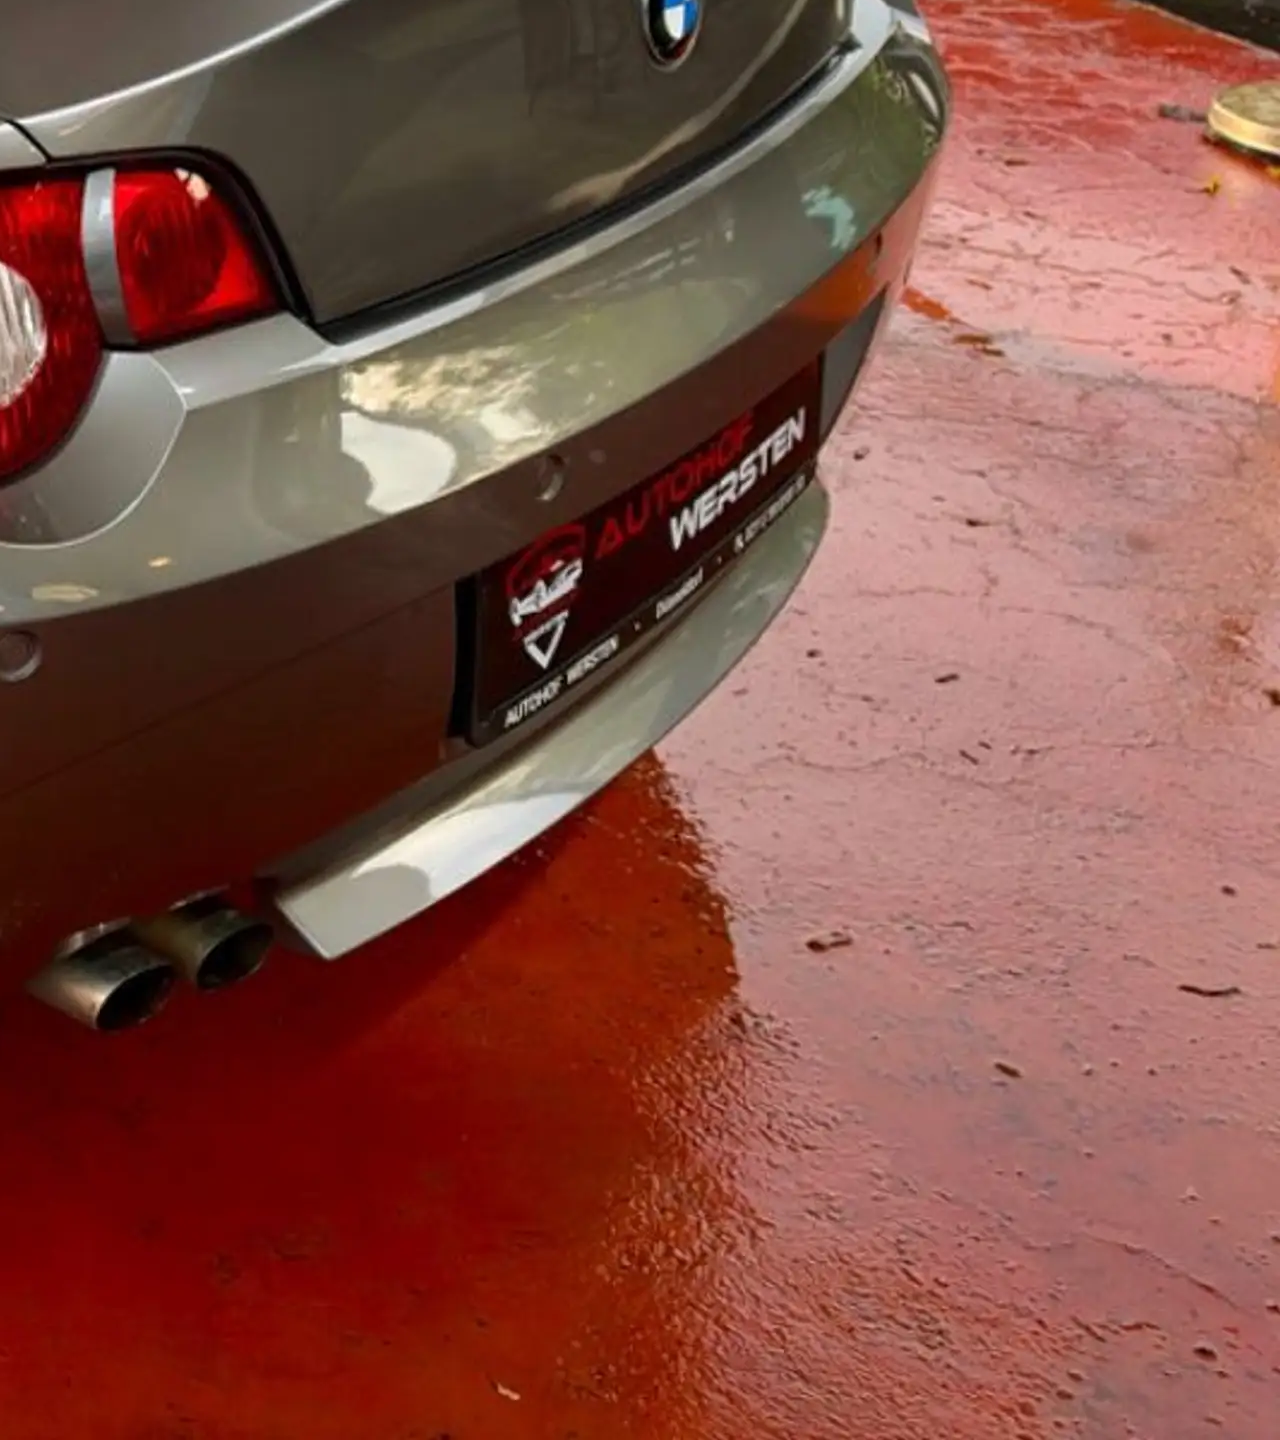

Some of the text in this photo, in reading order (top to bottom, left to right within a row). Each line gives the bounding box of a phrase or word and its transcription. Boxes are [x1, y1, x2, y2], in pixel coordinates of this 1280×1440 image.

[595, 411, 753, 559] AUTOHOF
[670, 406, 806, 551] WERSTEN
[504, 674, 563, 728] AUTOHOF
